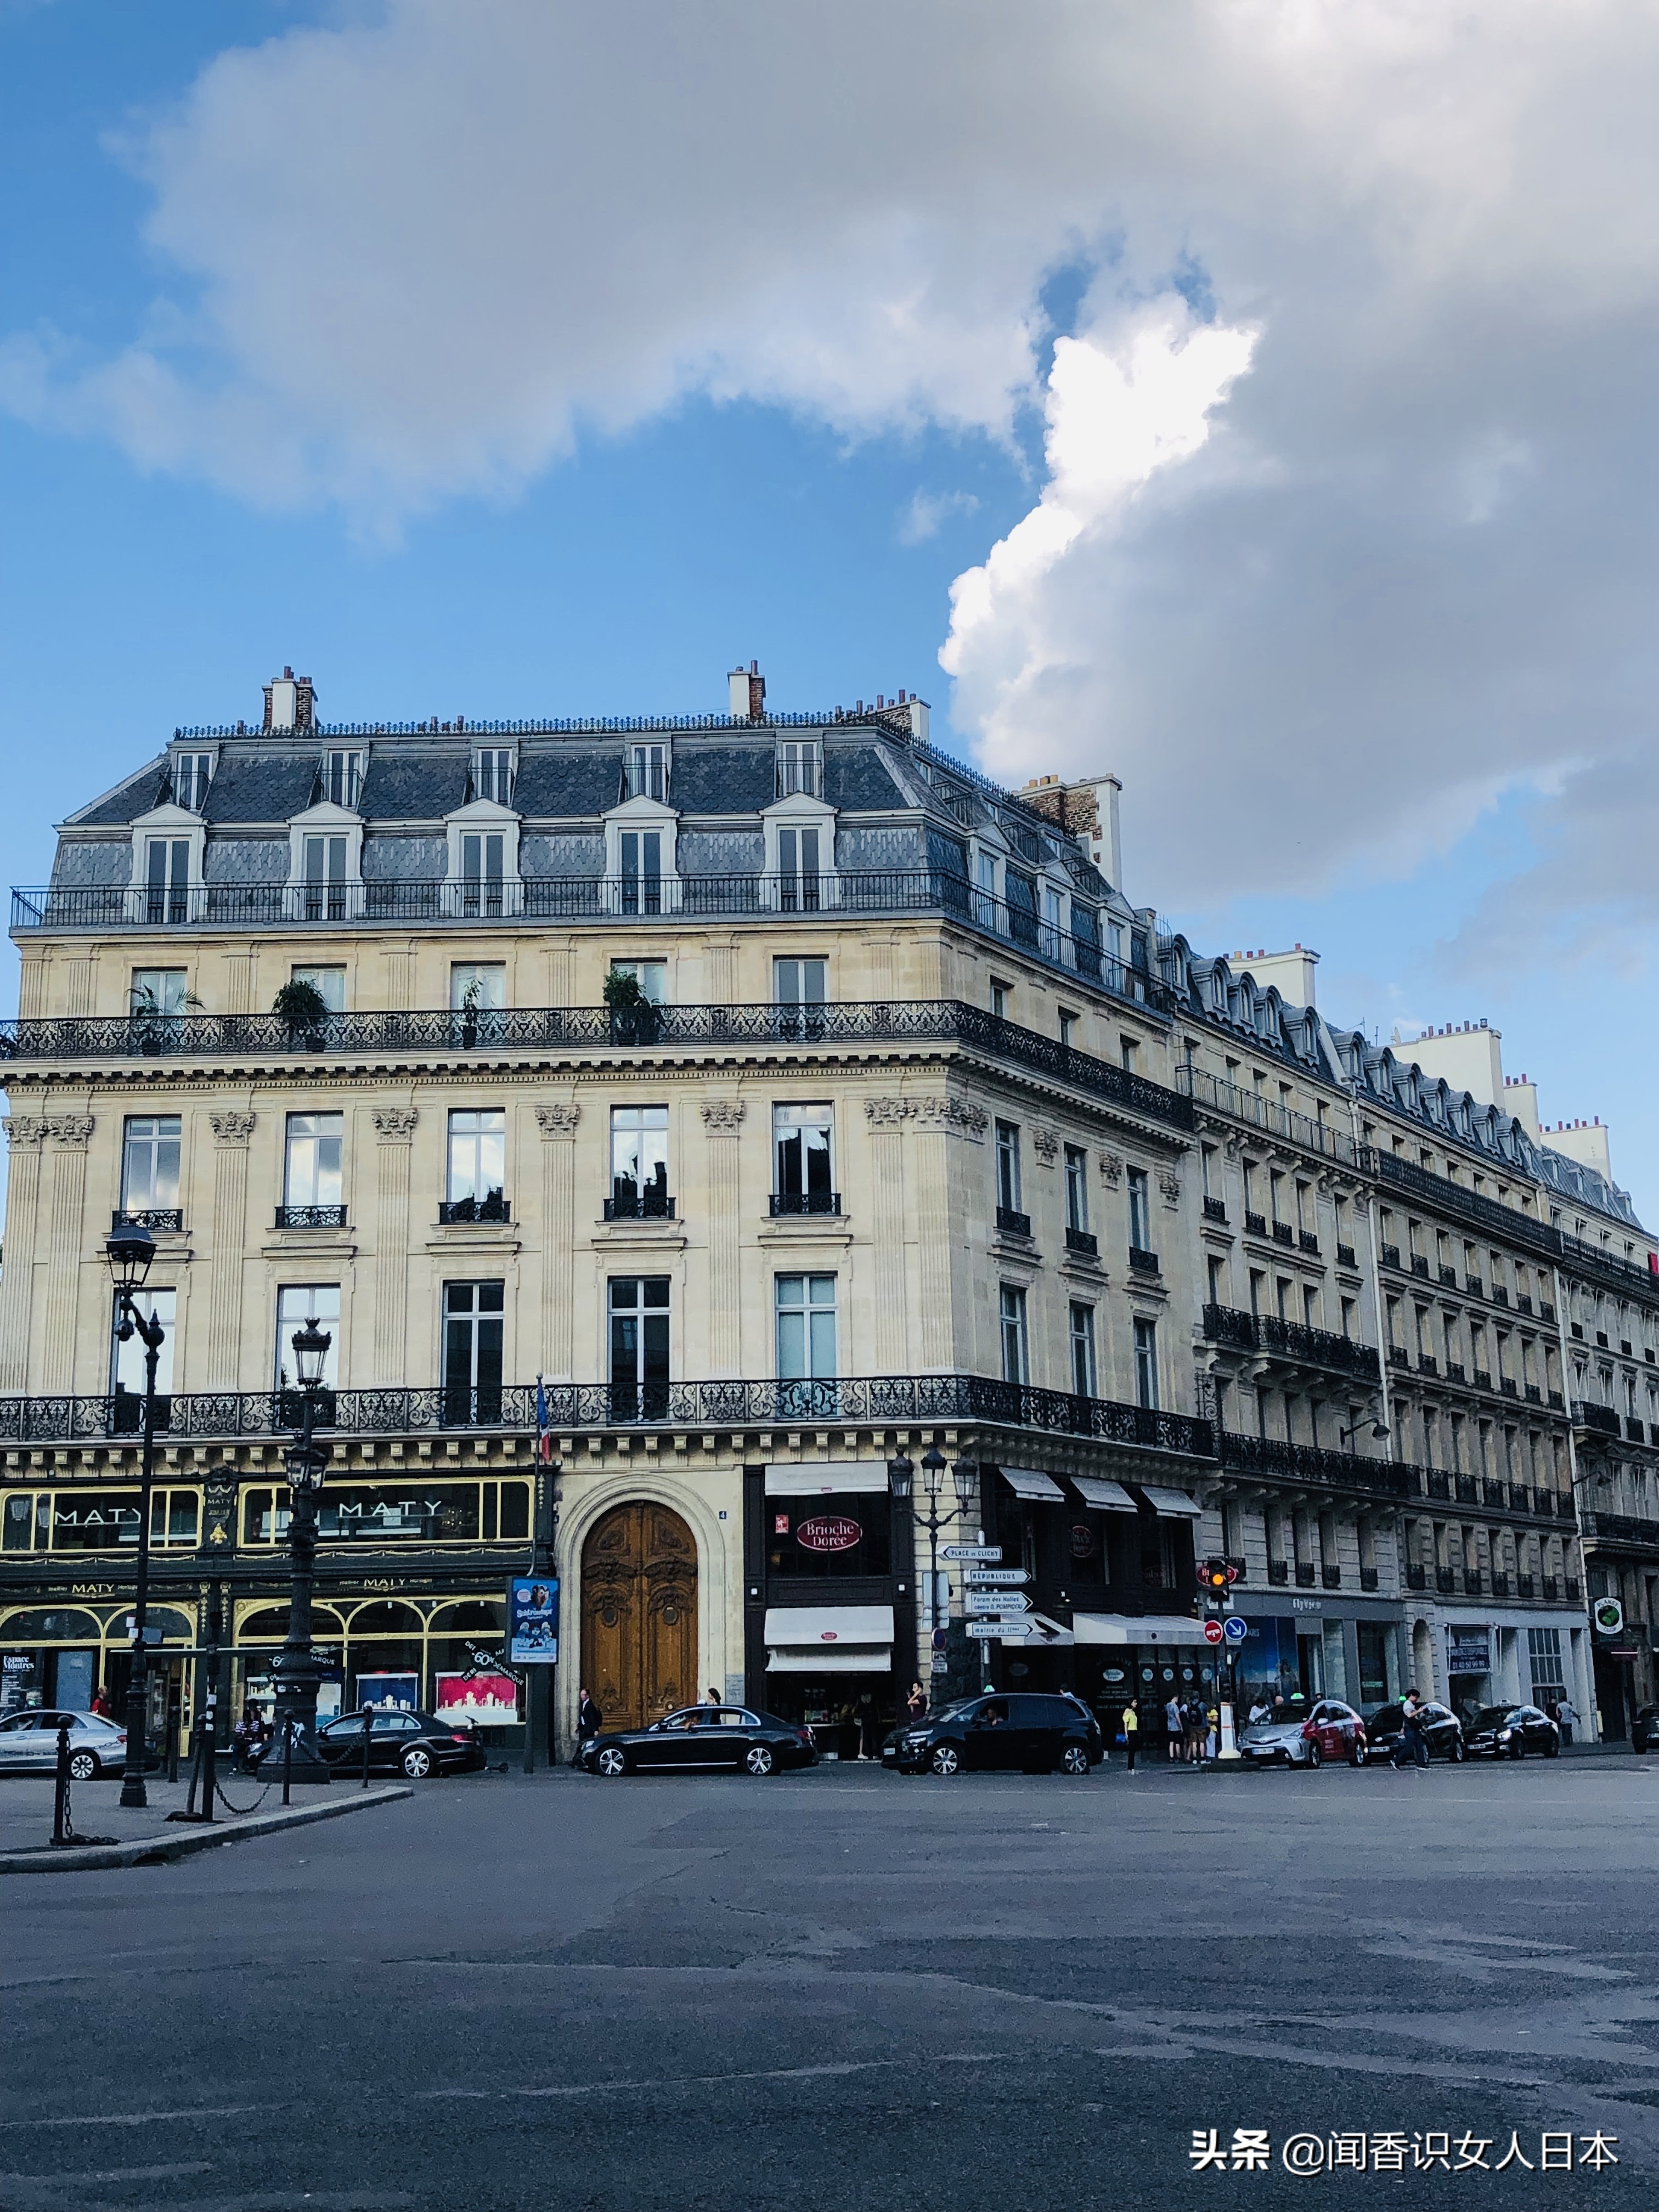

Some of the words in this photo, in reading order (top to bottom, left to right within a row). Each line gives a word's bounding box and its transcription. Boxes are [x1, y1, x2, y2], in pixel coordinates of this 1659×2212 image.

[339, 1501, 442, 1517] MATY
[807, 1521, 854, 1537] Brioche
[813, 1535, 847, 1546] Dorée
[72, 1583, 114, 1593] MATY
[364, 1578, 405, 1587] MATY
